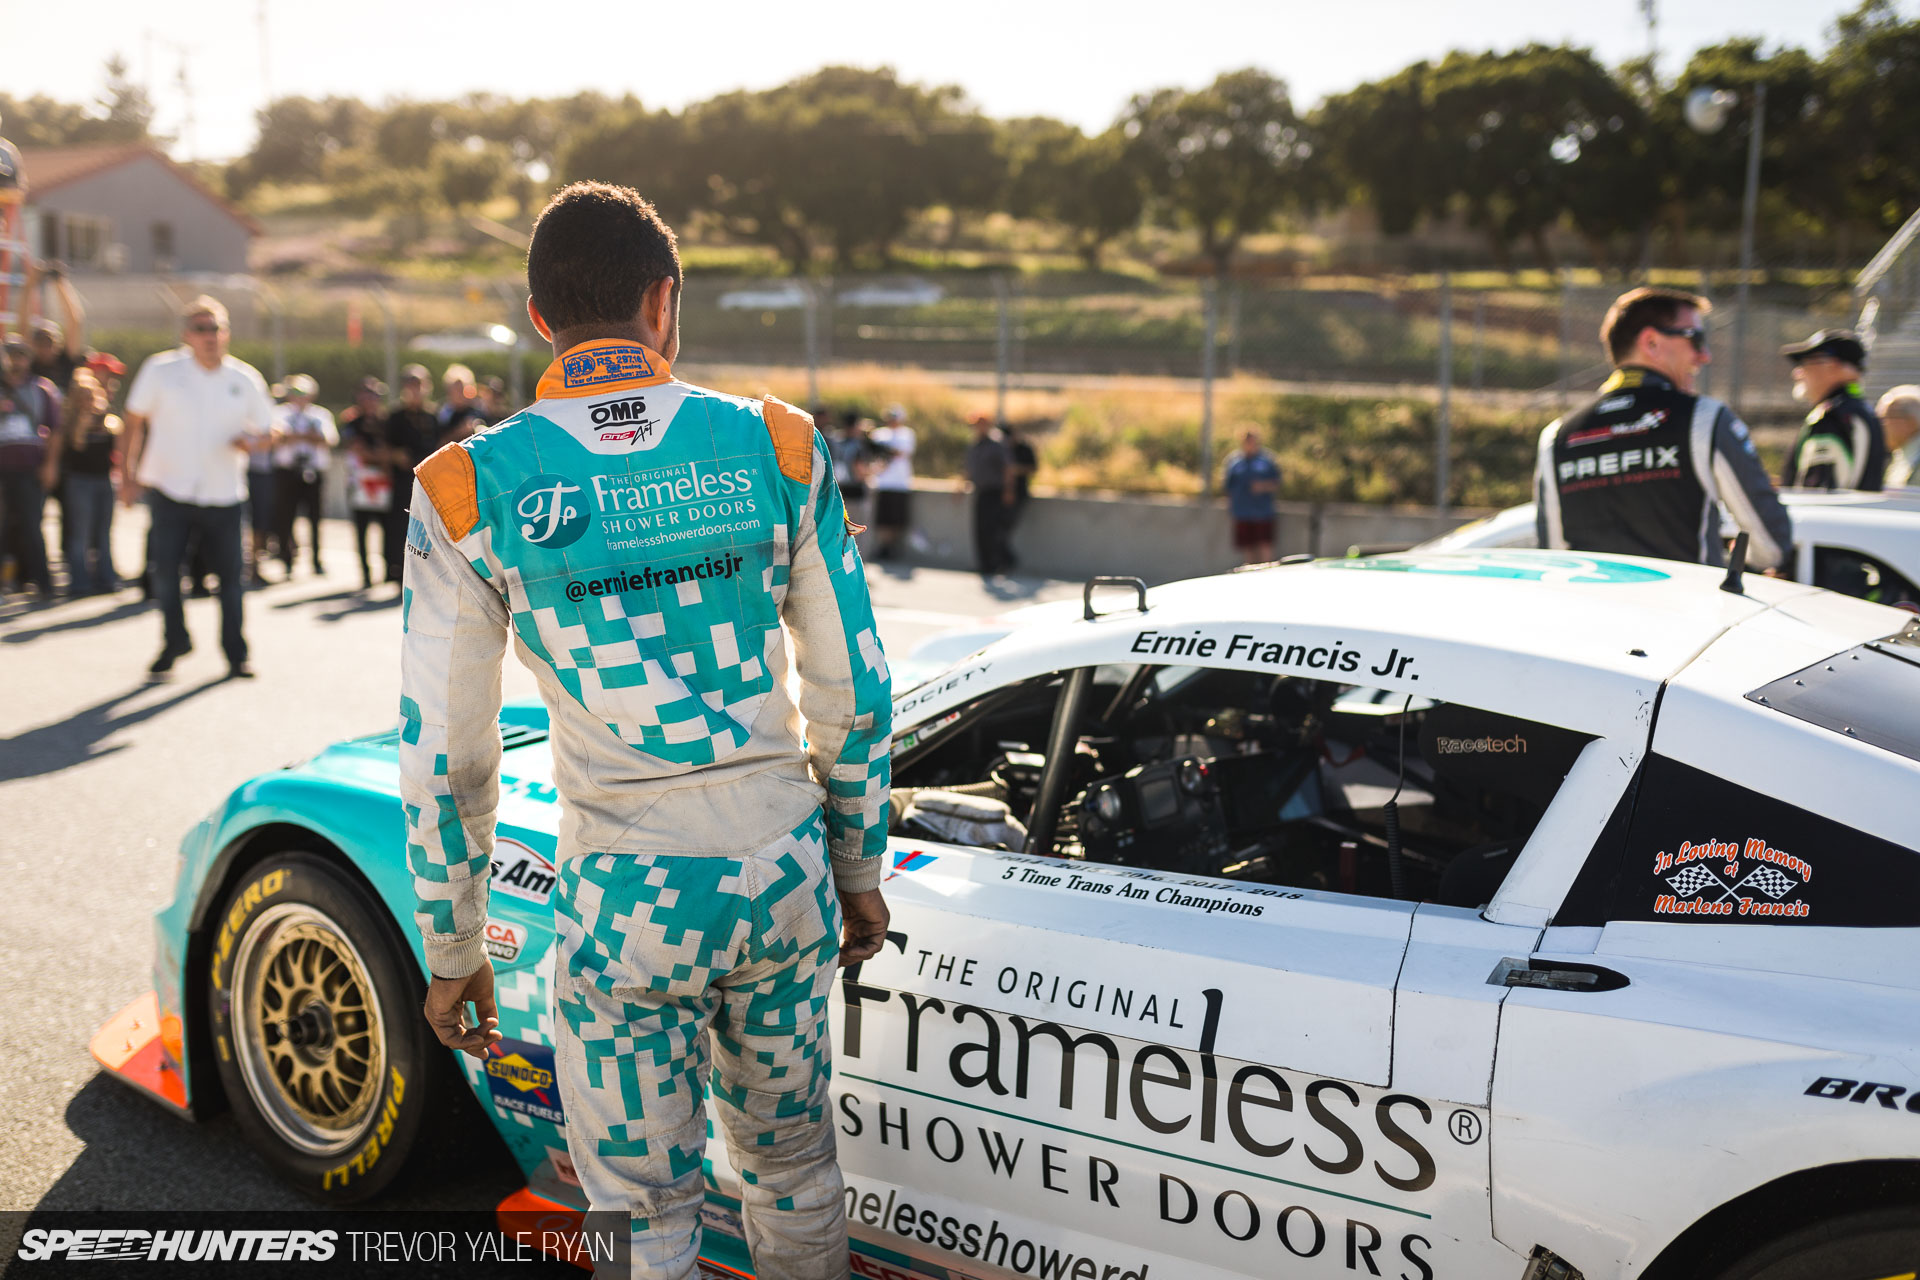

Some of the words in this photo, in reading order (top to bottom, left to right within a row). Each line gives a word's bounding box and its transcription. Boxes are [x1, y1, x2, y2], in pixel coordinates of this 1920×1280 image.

[591, 401, 646, 424] OMP
[631, 419, 660, 445] Art
[610, 476, 630, 485] THE
[634, 466, 687, 483] ORIGINAL
[1559, 445, 1679, 482] PREFIX
[590, 462, 752, 512] Frameless
[602, 511, 680, 534] SHOWER
[688, 499, 756, 521] DOORS
[607, 518, 761, 550] framelessshowerdoors.com
[565, 552, 743, 602] @erniefrancisjr
[1131, 631, 1217, 657] Ernie
[1225, 634, 1361, 673] Francis
[1371, 648, 1419, 681] Jr.
[1437, 734, 1527, 753] Racetech
[1653, 851, 1673, 875] In
[1674, 838, 1739, 865] Loving
[1743, 837, 1812, 882] Memory
[1723, 861, 1739, 878] of
[1002, 866, 1017, 880] 5
[1018, 868, 1062, 887] Time
[1065, 874, 1114, 895] Trans
[1115, 882, 1150, 901] Am
[1155, 887, 1265, 917] Champions
[1246, 887, 1304, 900] 2018
[1654, 894, 1733, 915] Marlene
[1737, 897, 1810, 917] Francis
[917, 950, 978, 987] THE
[997, 966, 1184, 1029] ORIGINAL
[491, 1061, 548, 1087] SUNOCO
[843, 930, 1437, 1192] Frameless
[323, 1065, 405, 1191] PIRELLI
[527, 1103, 563, 1123] FUELS
[839, 1092, 1120, 1208] SHOWER
[1159, 1173, 1434, 1280] DOORS
